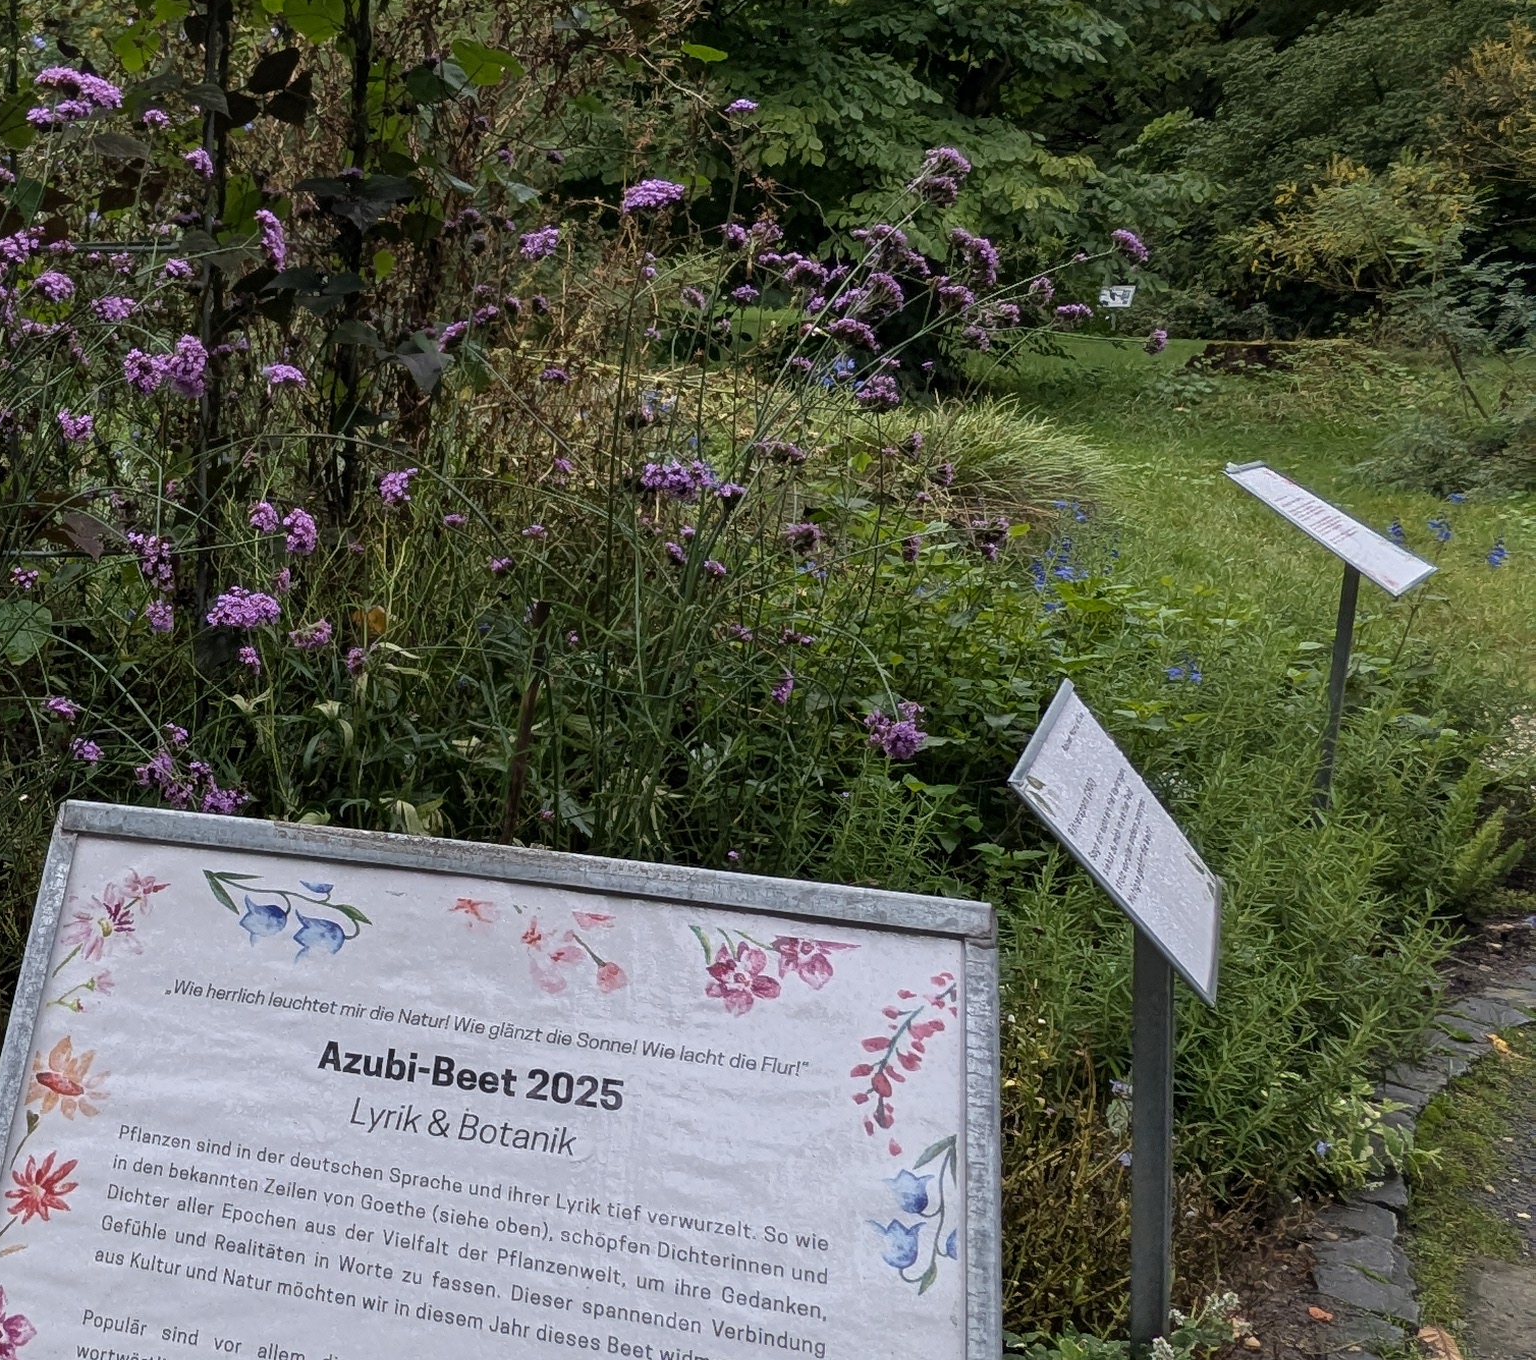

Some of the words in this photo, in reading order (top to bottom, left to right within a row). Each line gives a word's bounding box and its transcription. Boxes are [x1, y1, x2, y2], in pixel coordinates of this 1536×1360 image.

[204, 982, 266, 1006] herrlich
[267, 990, 339, 1016] leuchtet
[339, 1002, 368, 1019] mir
[368, 1004, 395, 1023] die
[397, 1007, 452, 1031] Natur!
[453, 1015, 486, 1035] Wie
[487, 1021, 544, 1044] glänzt
[545, 1028, 573, 1047] die
[575, 1031, 639, 1056] Sonne!
[641, 1039, 676, 1060] Wie
[678, 1044, 727, 1068] lacht
[728, 1052, 758, 1072] die
[316, 1039, 518, 1098] Azubi-Beet
[525, 1067, 625, 1112] 2025
[349, 1096, 423, 1135] Lyrik
[426, 1108, 451, 1139] &
[456, 1112, 578, 1157] Botanik
[112, 1153, 128, 1171] in
[132, 1156, 164, 1177] den
[167, 1161, 259, 1193] bekannten
[263, 1177, 318, 1202] Zeilen
[322, 1191, 355, 1208] von
[360, 1193, 427, 1220] Goethe
[431, 1203, 489, 1230] (siehe
[495, 1215, 554, 1243] oben),
[560, 1228, 651, 1257] schöpfen
[657, 1240, 785, 1279] Dichterinnen
[791, 1266, 829, 1286] und
[117, 1123, 192, 1151] Pflanzen
[195, 1137, 233, 1158] sind
[235, 1142, 252, 1161] in
[255, 1146, 286, 1165] der
[289, 1151, 384, 1182] deutschen
[388, 1166, 463, 1194] Sprache
[468, 1183, 503, 1200] und
[507, 1184, 551, 1208] ihrer
[555, 1192, 602, 1216] Lyrik
[606, 1201, 642, 1222] tief
[646, 1210, 757, 1241] verwurzelt.
[763, 1225, 789, 1246] So
[795, 1232, 829, 1252] wie
[81, 1308, 149, 1337] Populär
[161, 1325, 200, 1347] sind
[213, 1336, 243, 1355] vor
